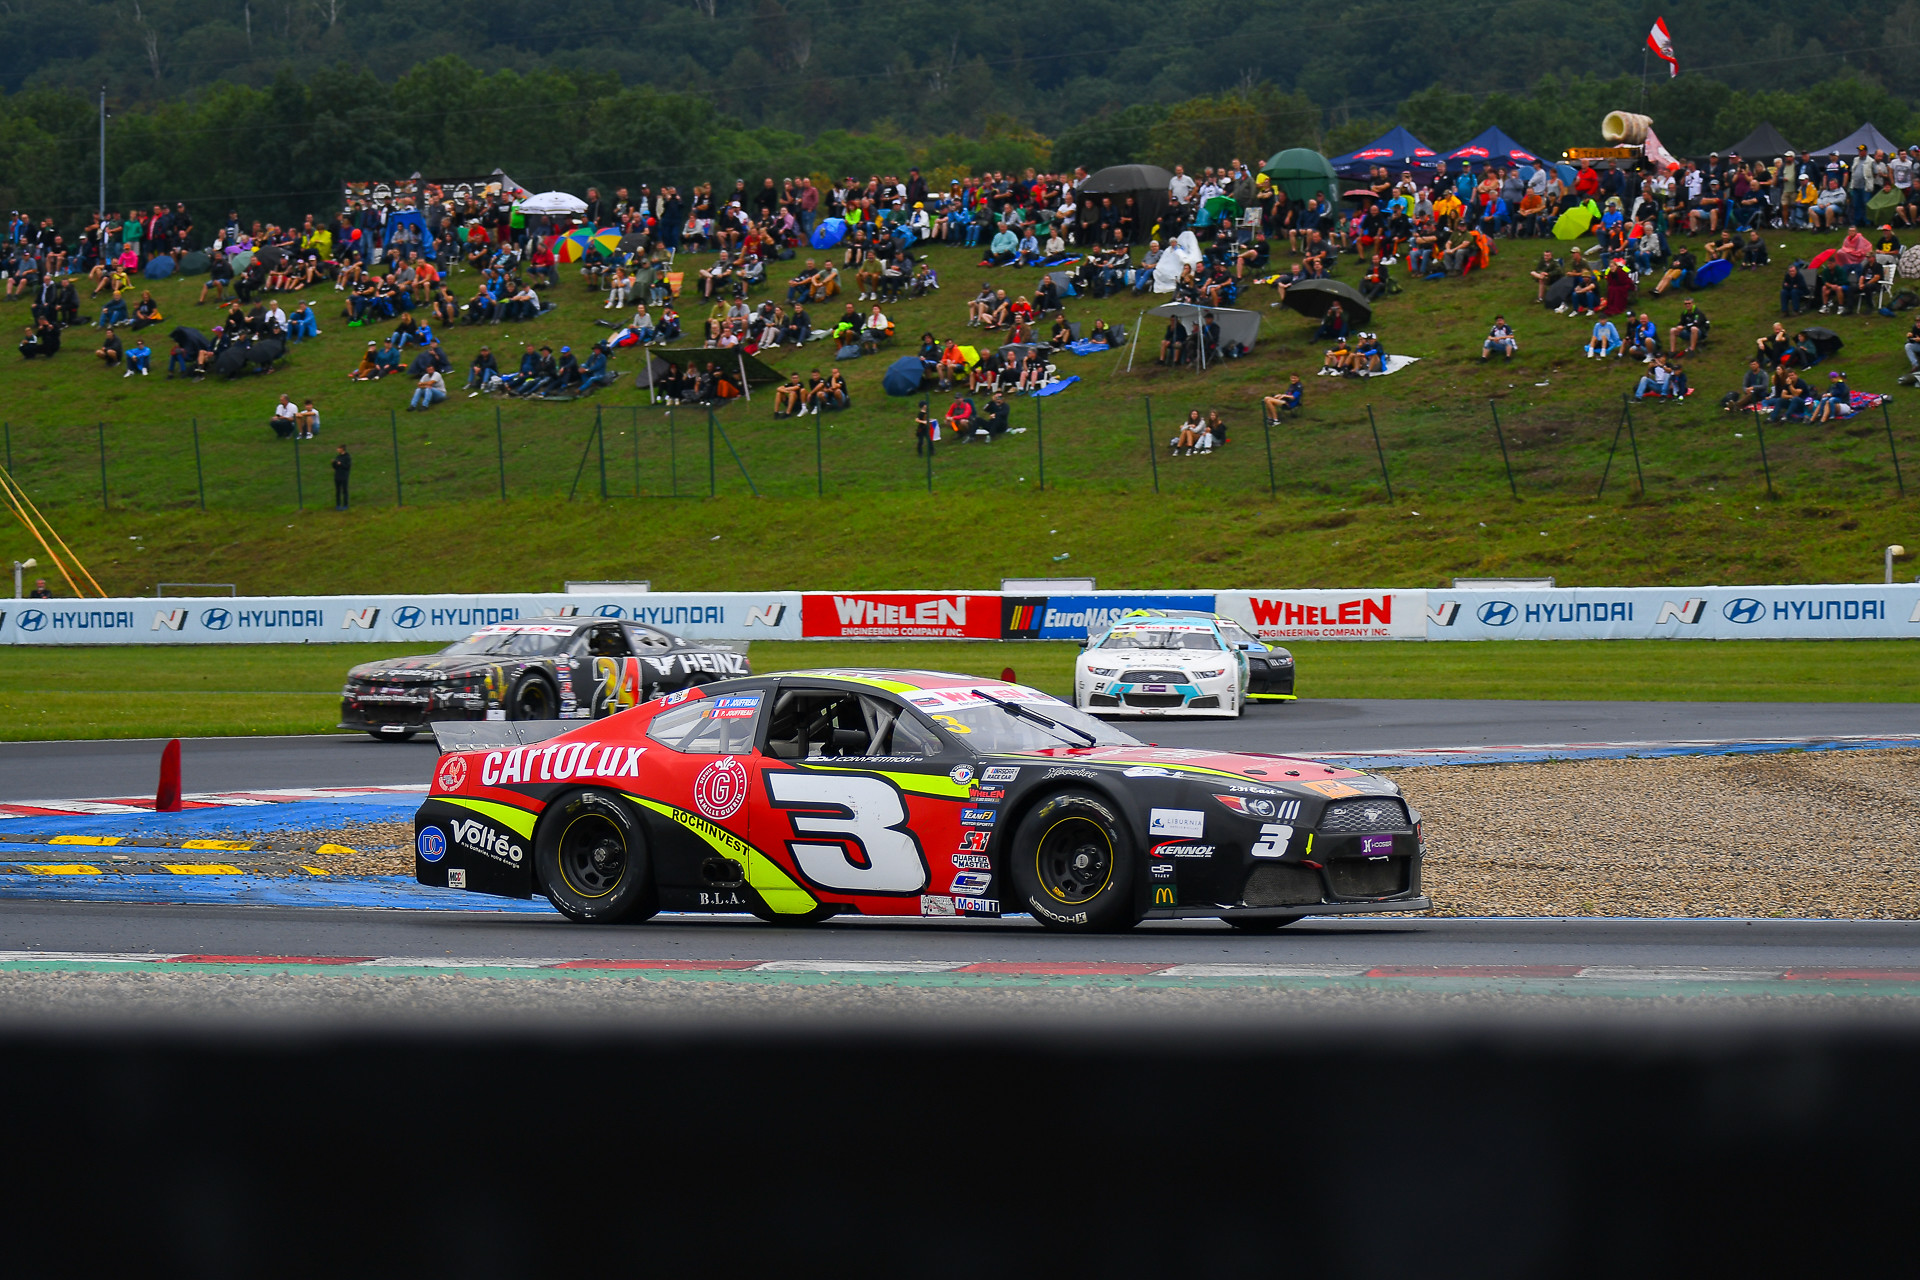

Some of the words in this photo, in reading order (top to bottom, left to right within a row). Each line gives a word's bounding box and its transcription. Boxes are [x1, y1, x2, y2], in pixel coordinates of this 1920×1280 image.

[238, 610, 324, 628] HYUNDAI
[431, 607, 520, 626] HYUNDAI
[633, 605, 724, 624] HYUNDAI
[833, 596, 967, 626] WHELEN
[1249, 594, 1392, 626] WHELEN
[1525, 603, 1633, 623] HYUNDAI
[1773, 600, 1885, 621] HYUNDAI
[53, 611, 134, 629] HYUNDAI
[841, 627, 899, 636] ENGINEERING
[901, 627, 944, 636] COMPANY
[946, 628, 965, 637] INC.
[1258, 628, 1320, 638] ENGINEERING
[1322, 628, 1368, 637] COMPANY
[1371, 628, 1390, 637] INC.
[677, 653, 749, 675] HEINZ
[931, 715, 971, 734] 3
[969, 788, 1005, 799] WHELEN
[1167, 818, 1202, 826] LIBURNIA
[672, 808, 751, 856] ROCHINVEST
[768, 772, 926, 893] 3
[1251, 823, 1294, 858] 3
[952, 854, 988, 864] QUARTER
[1154, 845, 1214, 855] KENNOL
[958, 861, 989, 869] MASTER
[958, 898, 986, 911] Mobil
